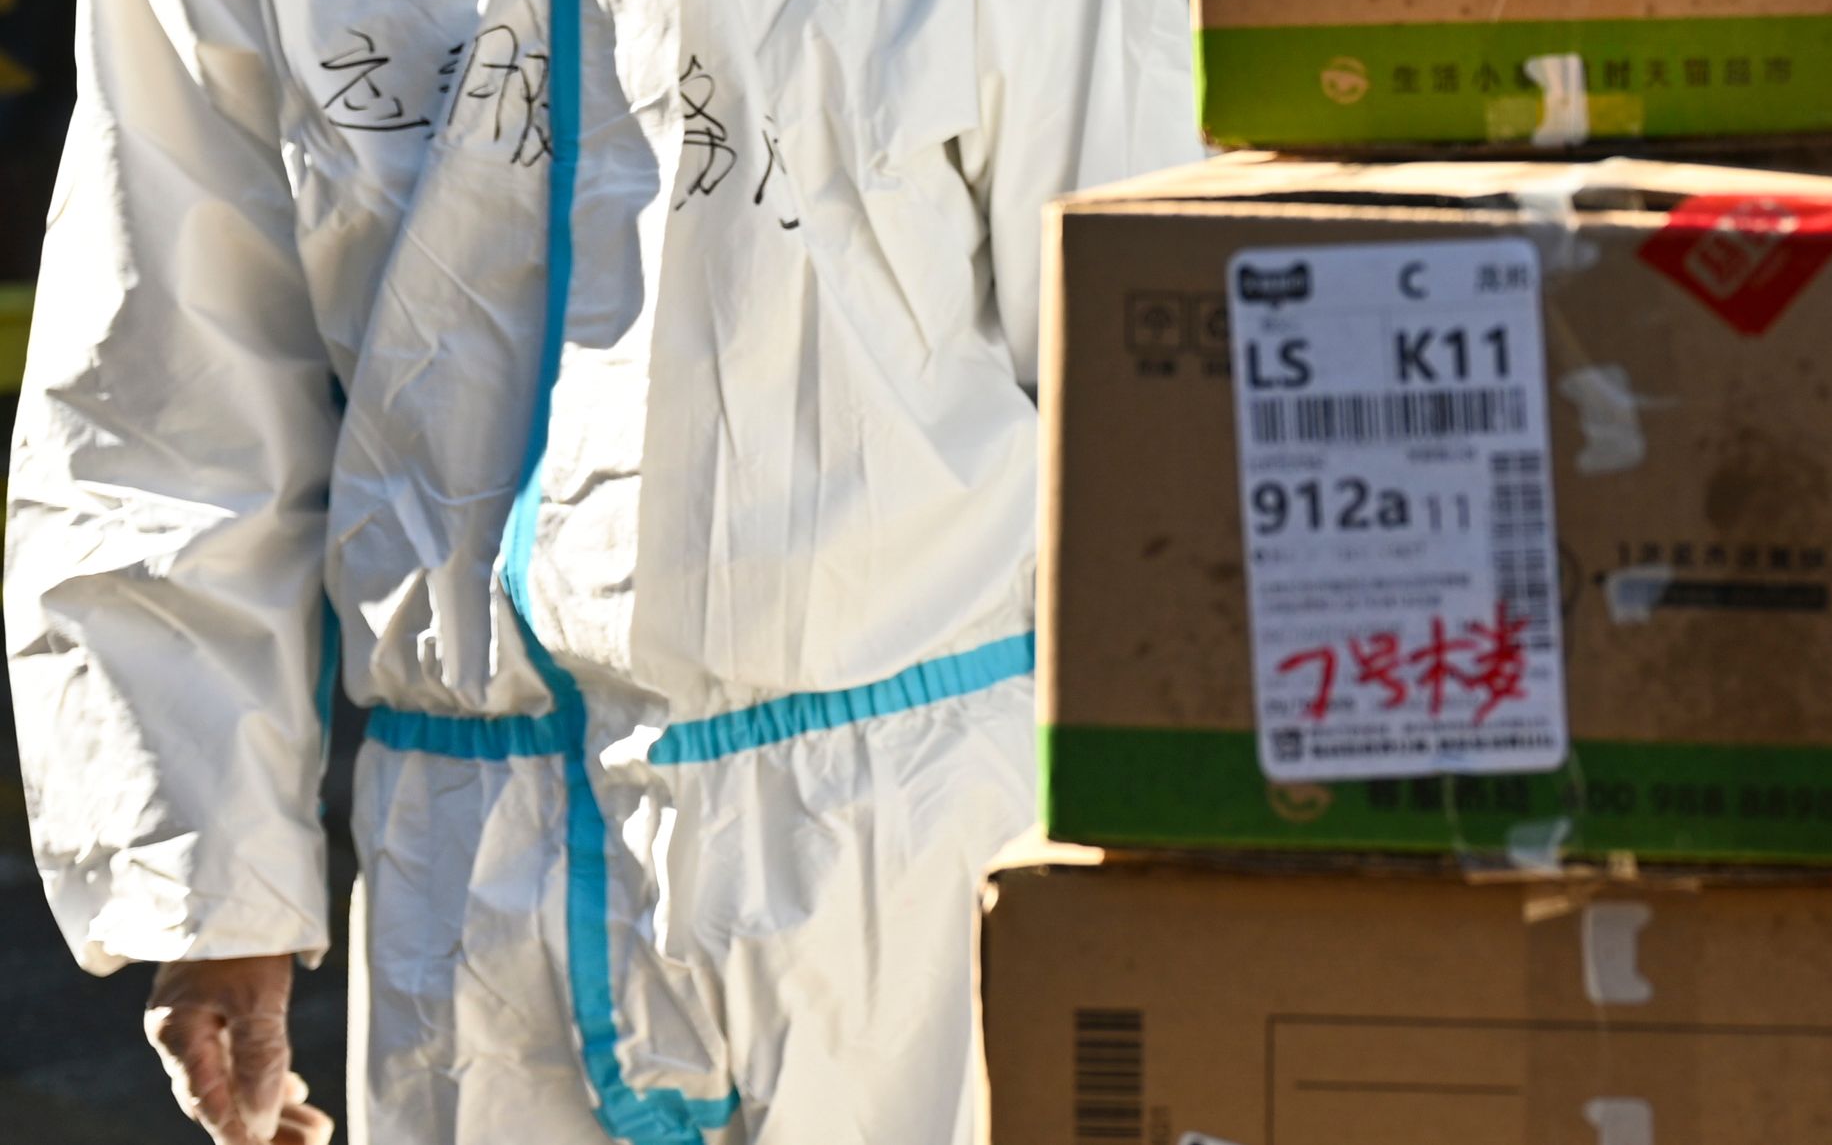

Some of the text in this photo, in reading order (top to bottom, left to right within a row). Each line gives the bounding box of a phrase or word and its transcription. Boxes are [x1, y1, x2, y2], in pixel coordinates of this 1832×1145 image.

[1399, 261, 1430, 300] C
[1246, 326, 1510, 391] LS K11
[1253, 476, 1412, 537] 912a
